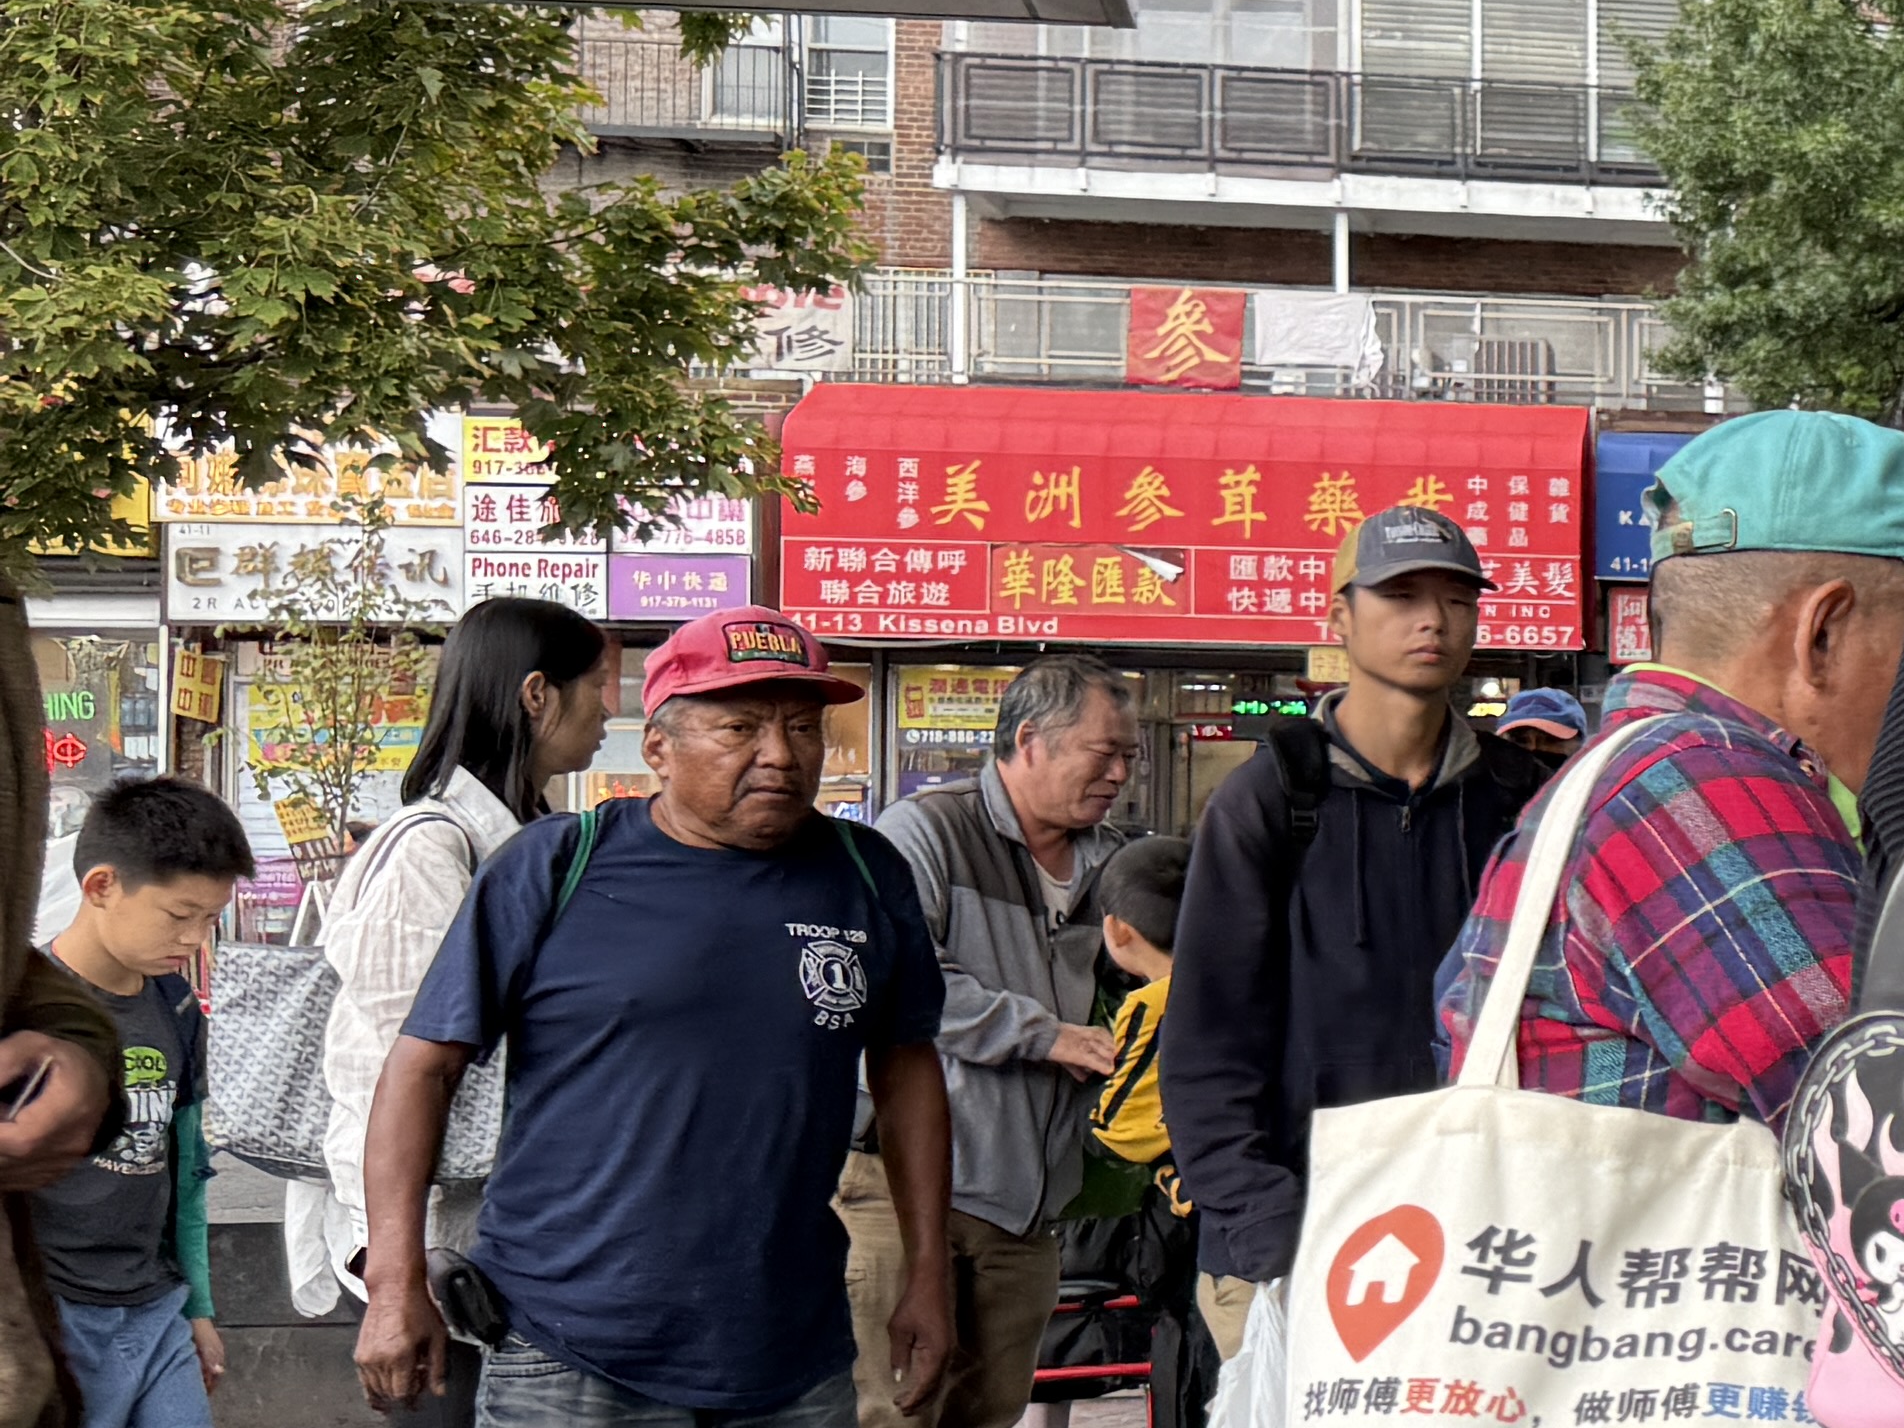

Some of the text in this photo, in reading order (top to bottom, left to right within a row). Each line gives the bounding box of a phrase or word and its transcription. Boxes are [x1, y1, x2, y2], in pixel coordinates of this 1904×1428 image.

[471, 557, 599, 585] Phone Repair
[879, 614, 989, 635] Kissena
[998, 614, 1058, 635] Blvd
[730, 630, 802, 655] PUEBLA
[785, 923, 840, 939] TROOP
[831, 962, 846, 990] 1
[1459, 1223, 1827, 1318] 华人帮帮网
